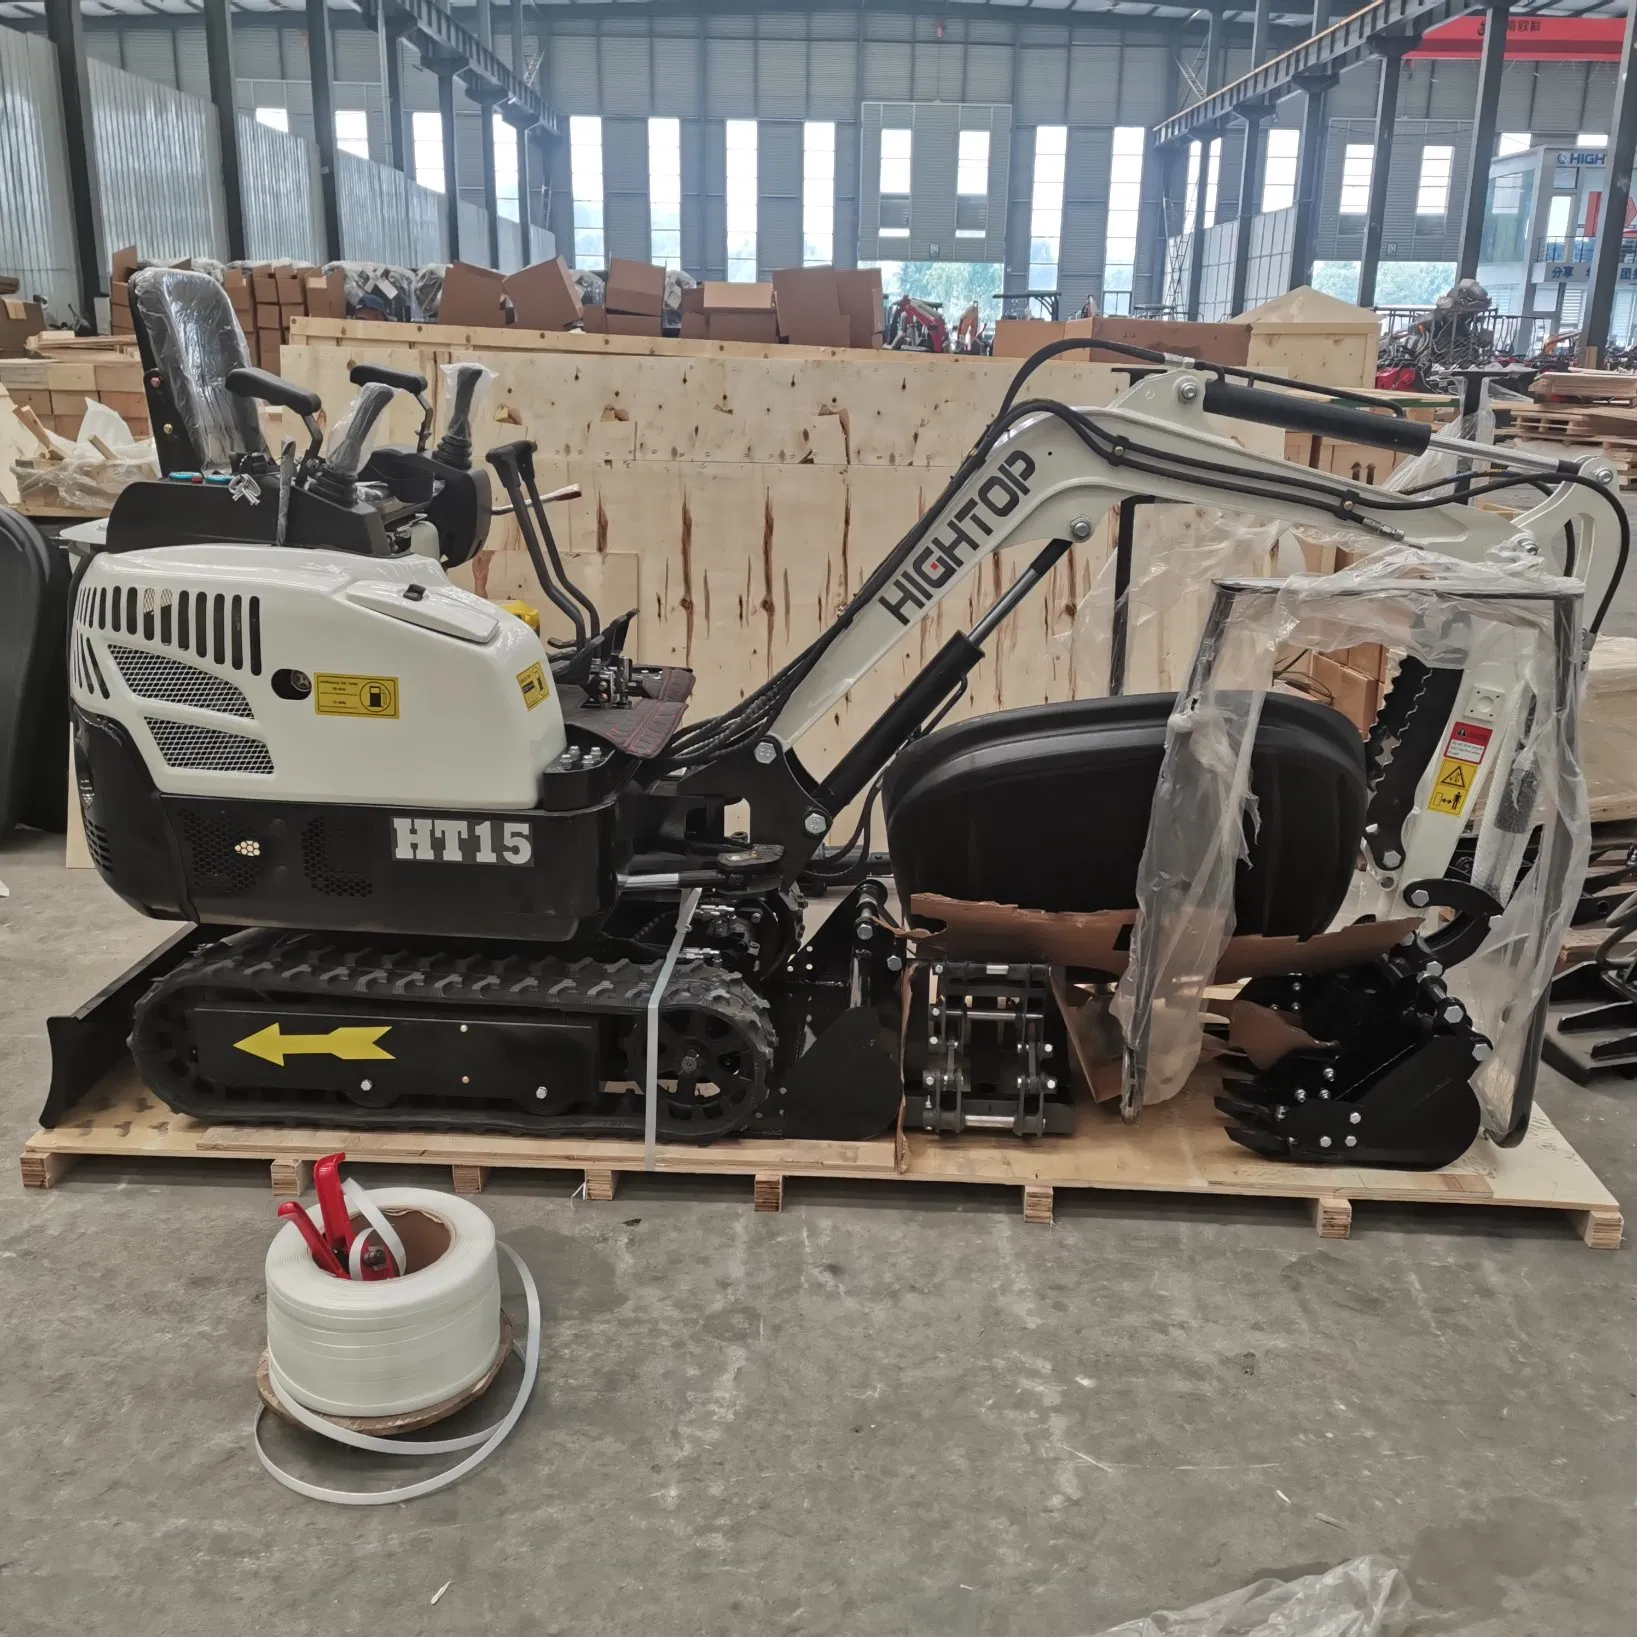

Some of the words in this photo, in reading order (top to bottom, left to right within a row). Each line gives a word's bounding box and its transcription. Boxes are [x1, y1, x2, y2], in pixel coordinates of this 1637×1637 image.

[1569, 152, 1608, 165] HIGH
[1551, 265, 1575, 279] 分享
[877, 449, 1037, 626] HIGHTOP
[393, 817, 532, 865] HT15
